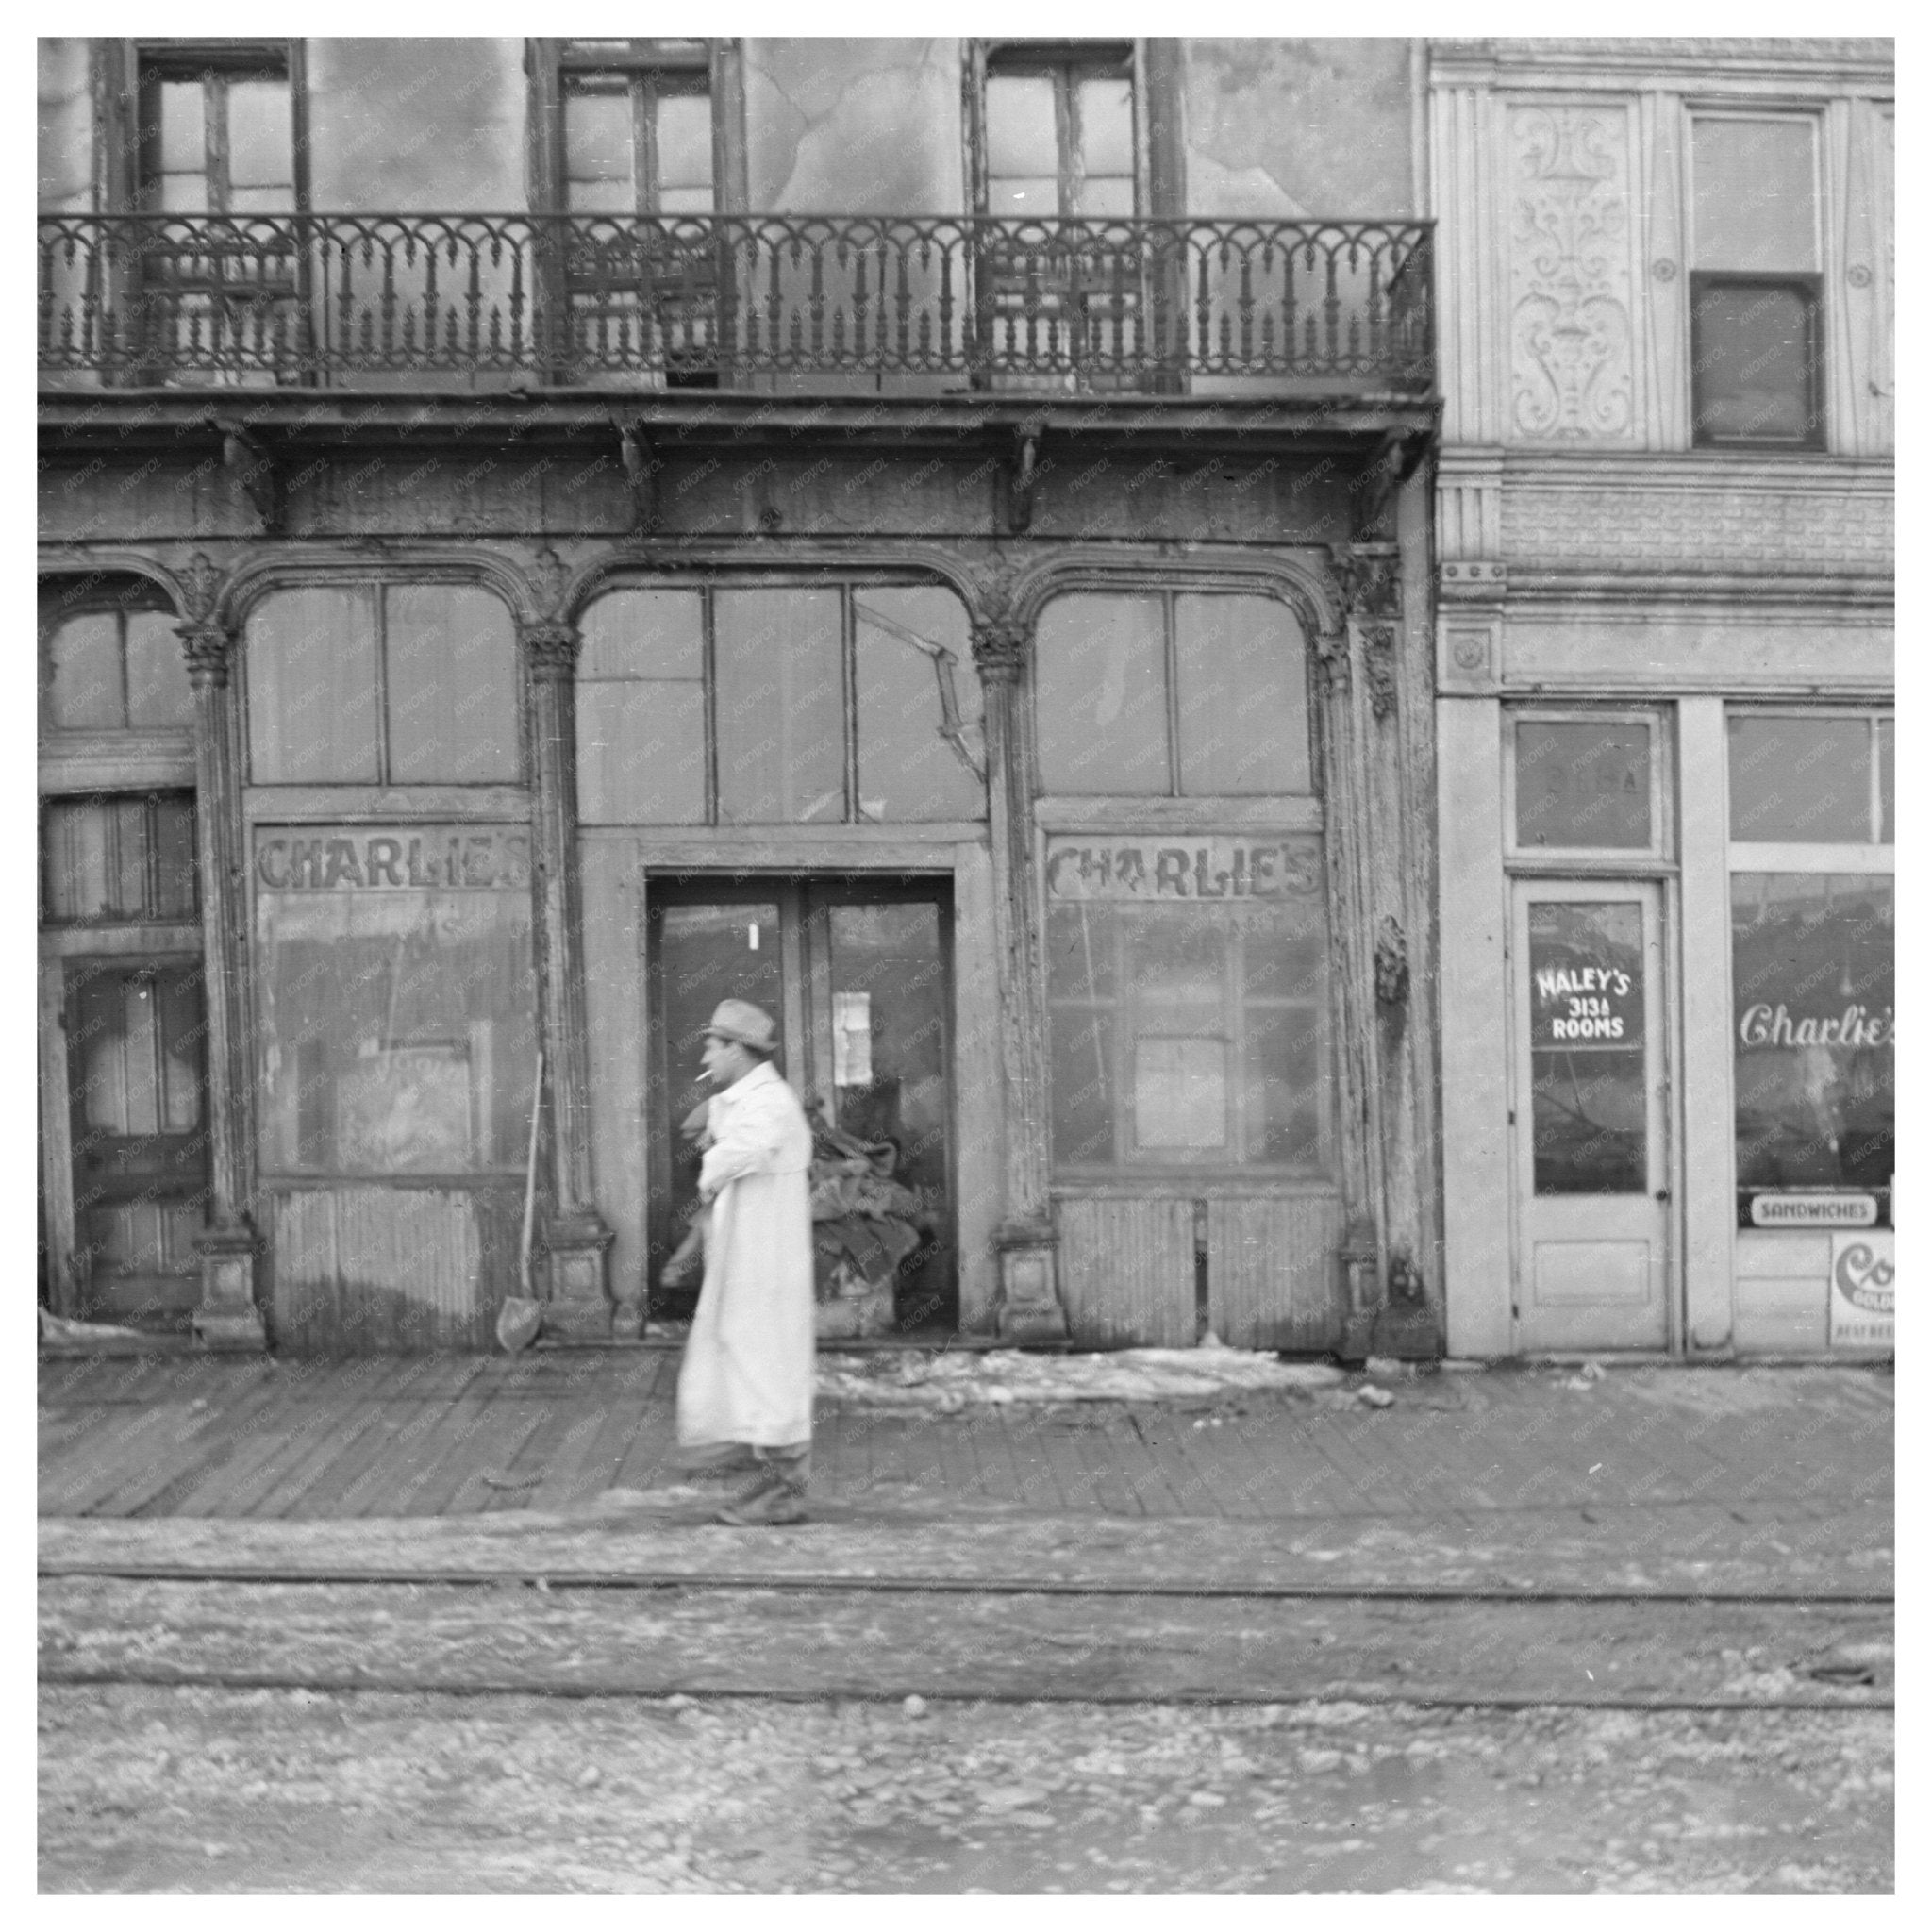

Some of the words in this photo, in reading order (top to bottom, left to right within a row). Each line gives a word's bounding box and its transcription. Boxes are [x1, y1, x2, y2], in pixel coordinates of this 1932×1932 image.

[258, 834, 527, 888] CHARLIE'S
[1045, 844, 1321, 897] CHARLIE'S
[1569, 997, 1609, 1017] 313A
[1553, 1017, 1624, 1038] ROOMS
[1761, 1202, 1868, 1219] SANDWICHES
